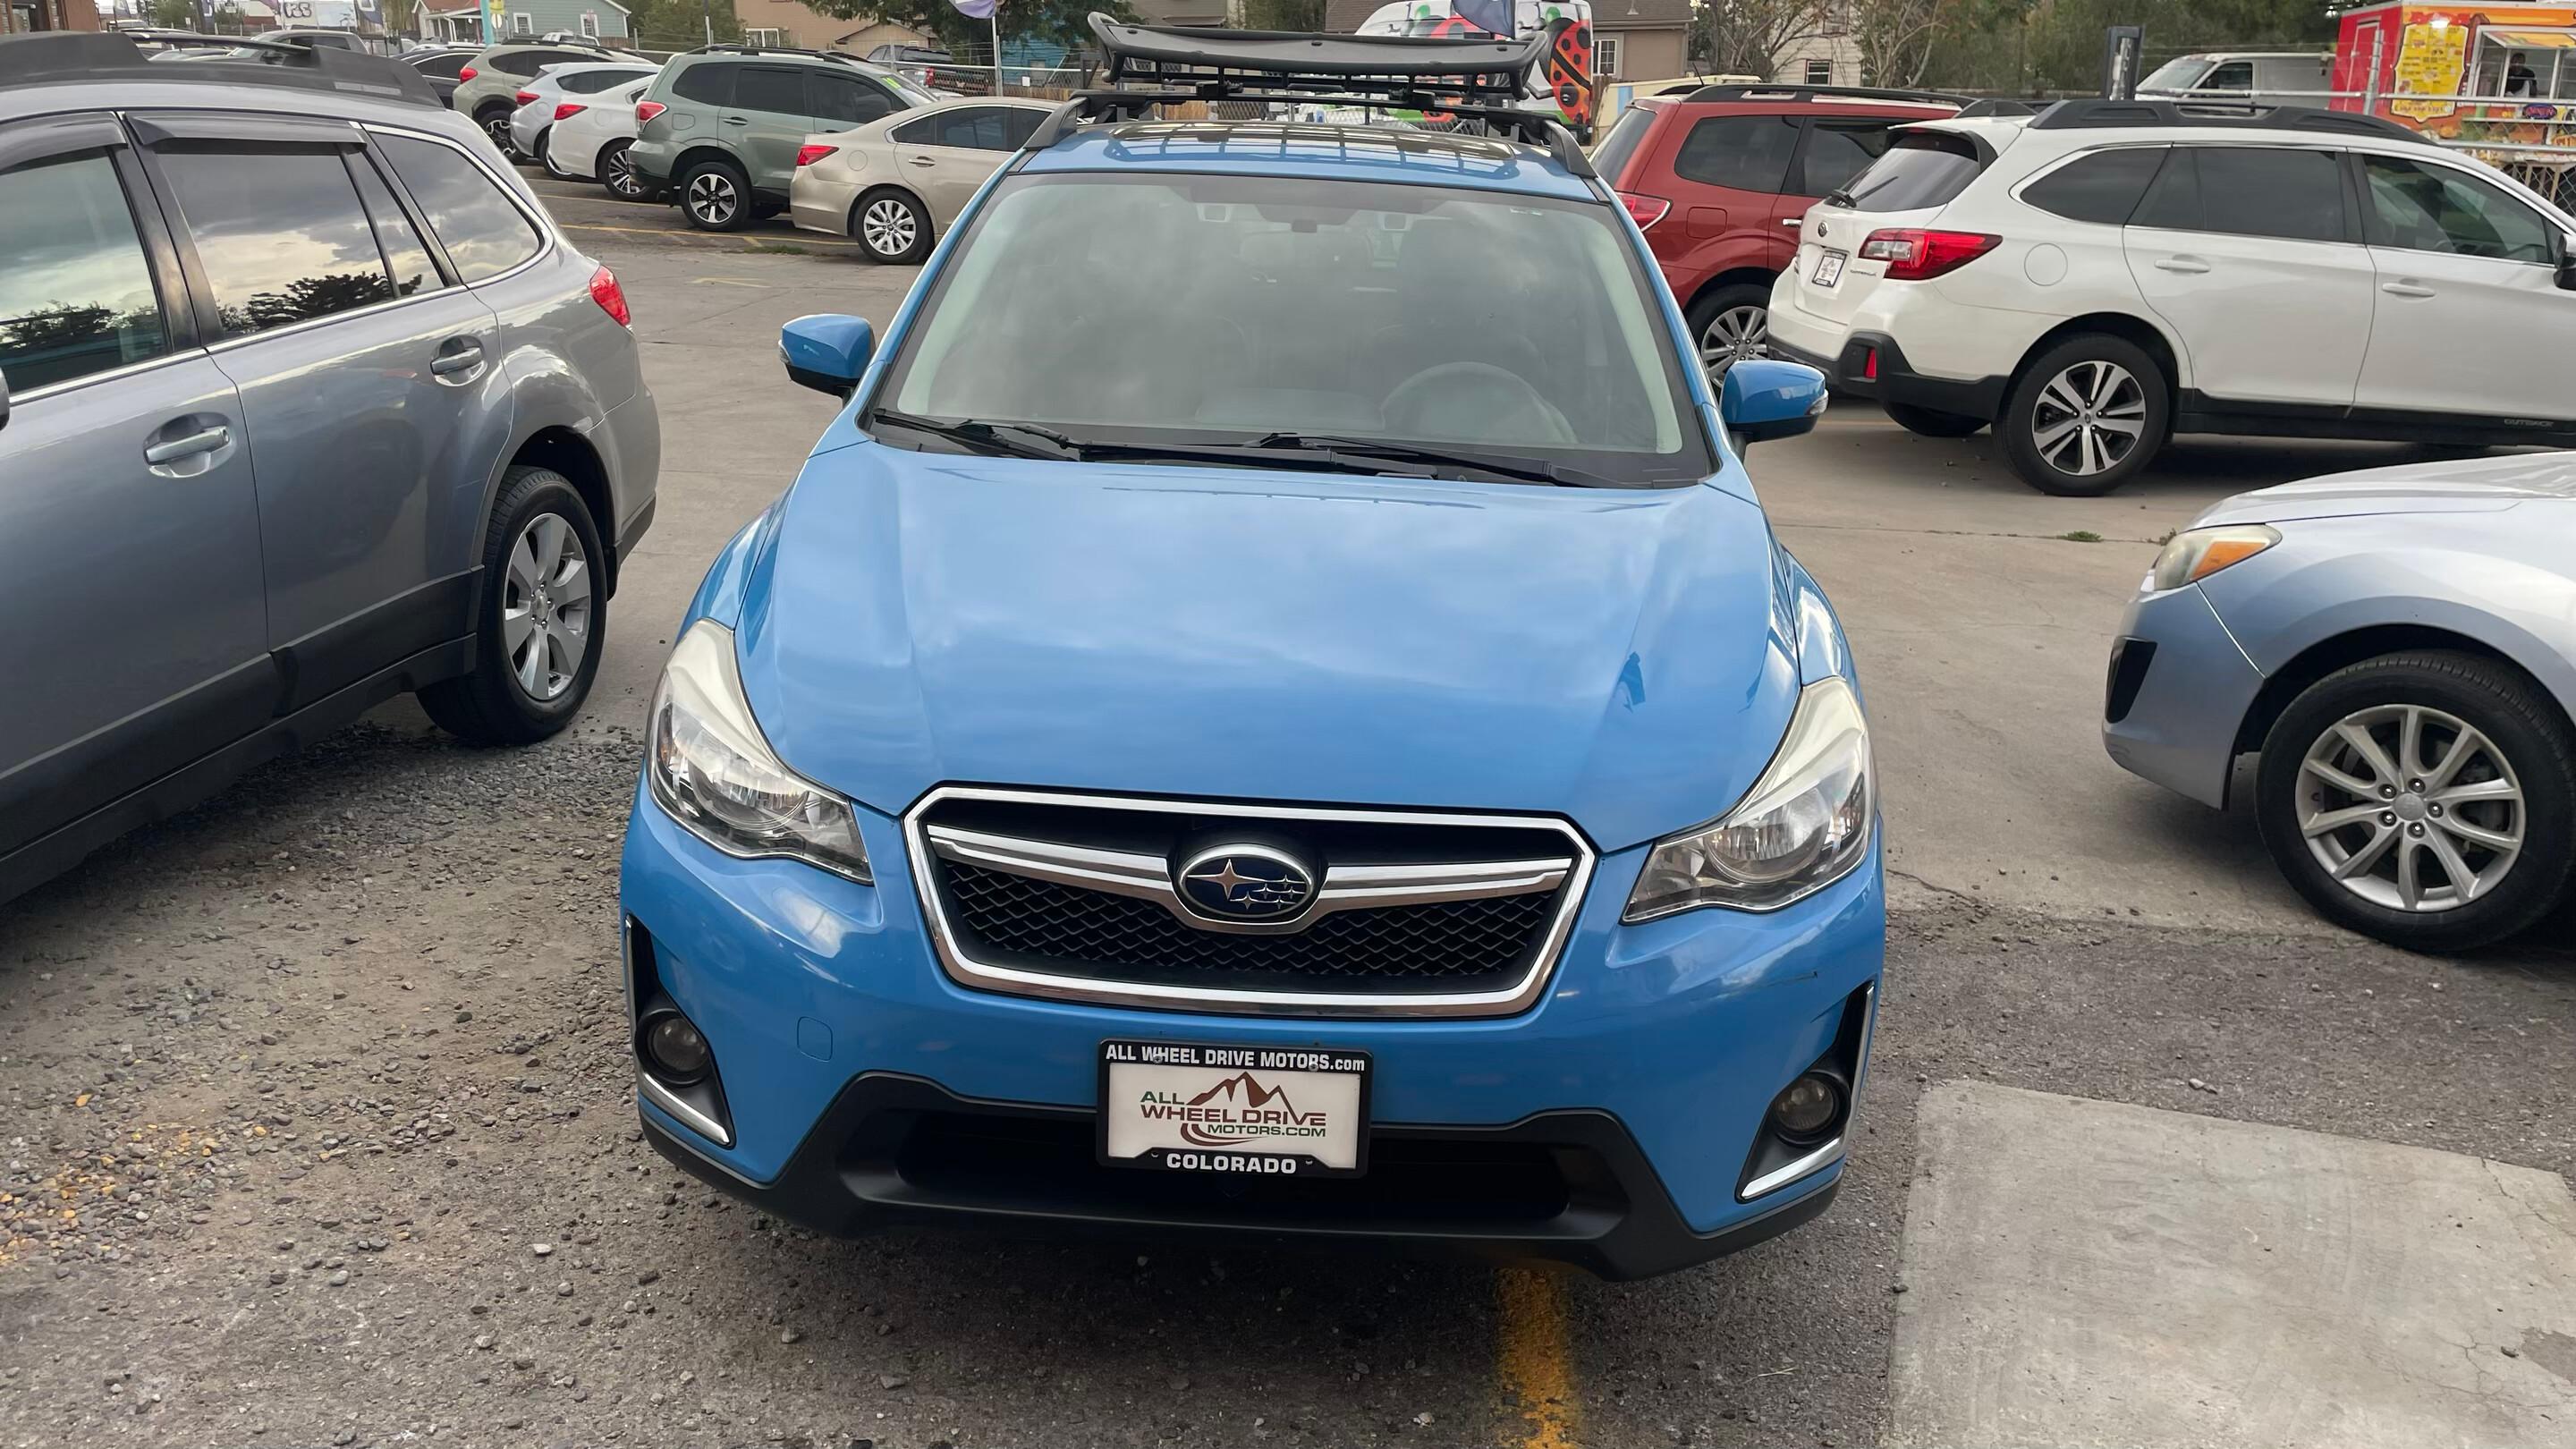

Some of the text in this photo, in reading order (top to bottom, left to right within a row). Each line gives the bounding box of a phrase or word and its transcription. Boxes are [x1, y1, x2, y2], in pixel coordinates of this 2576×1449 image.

[1106, 1044, 1137, 1061] ALL
[1141, 1046, 1199, 1064] WHEEL
[1205, 1049, 1255, 1067] DRIVE
[1140, 1090, 1185, 1106] ALL
[1140, 1105, 1326, 1126] WHEEL DRIVE
[1208, 1123, 1326, 1137] MOTORS.COM
[1166, 1153, 1297, 1174] COLORADO
